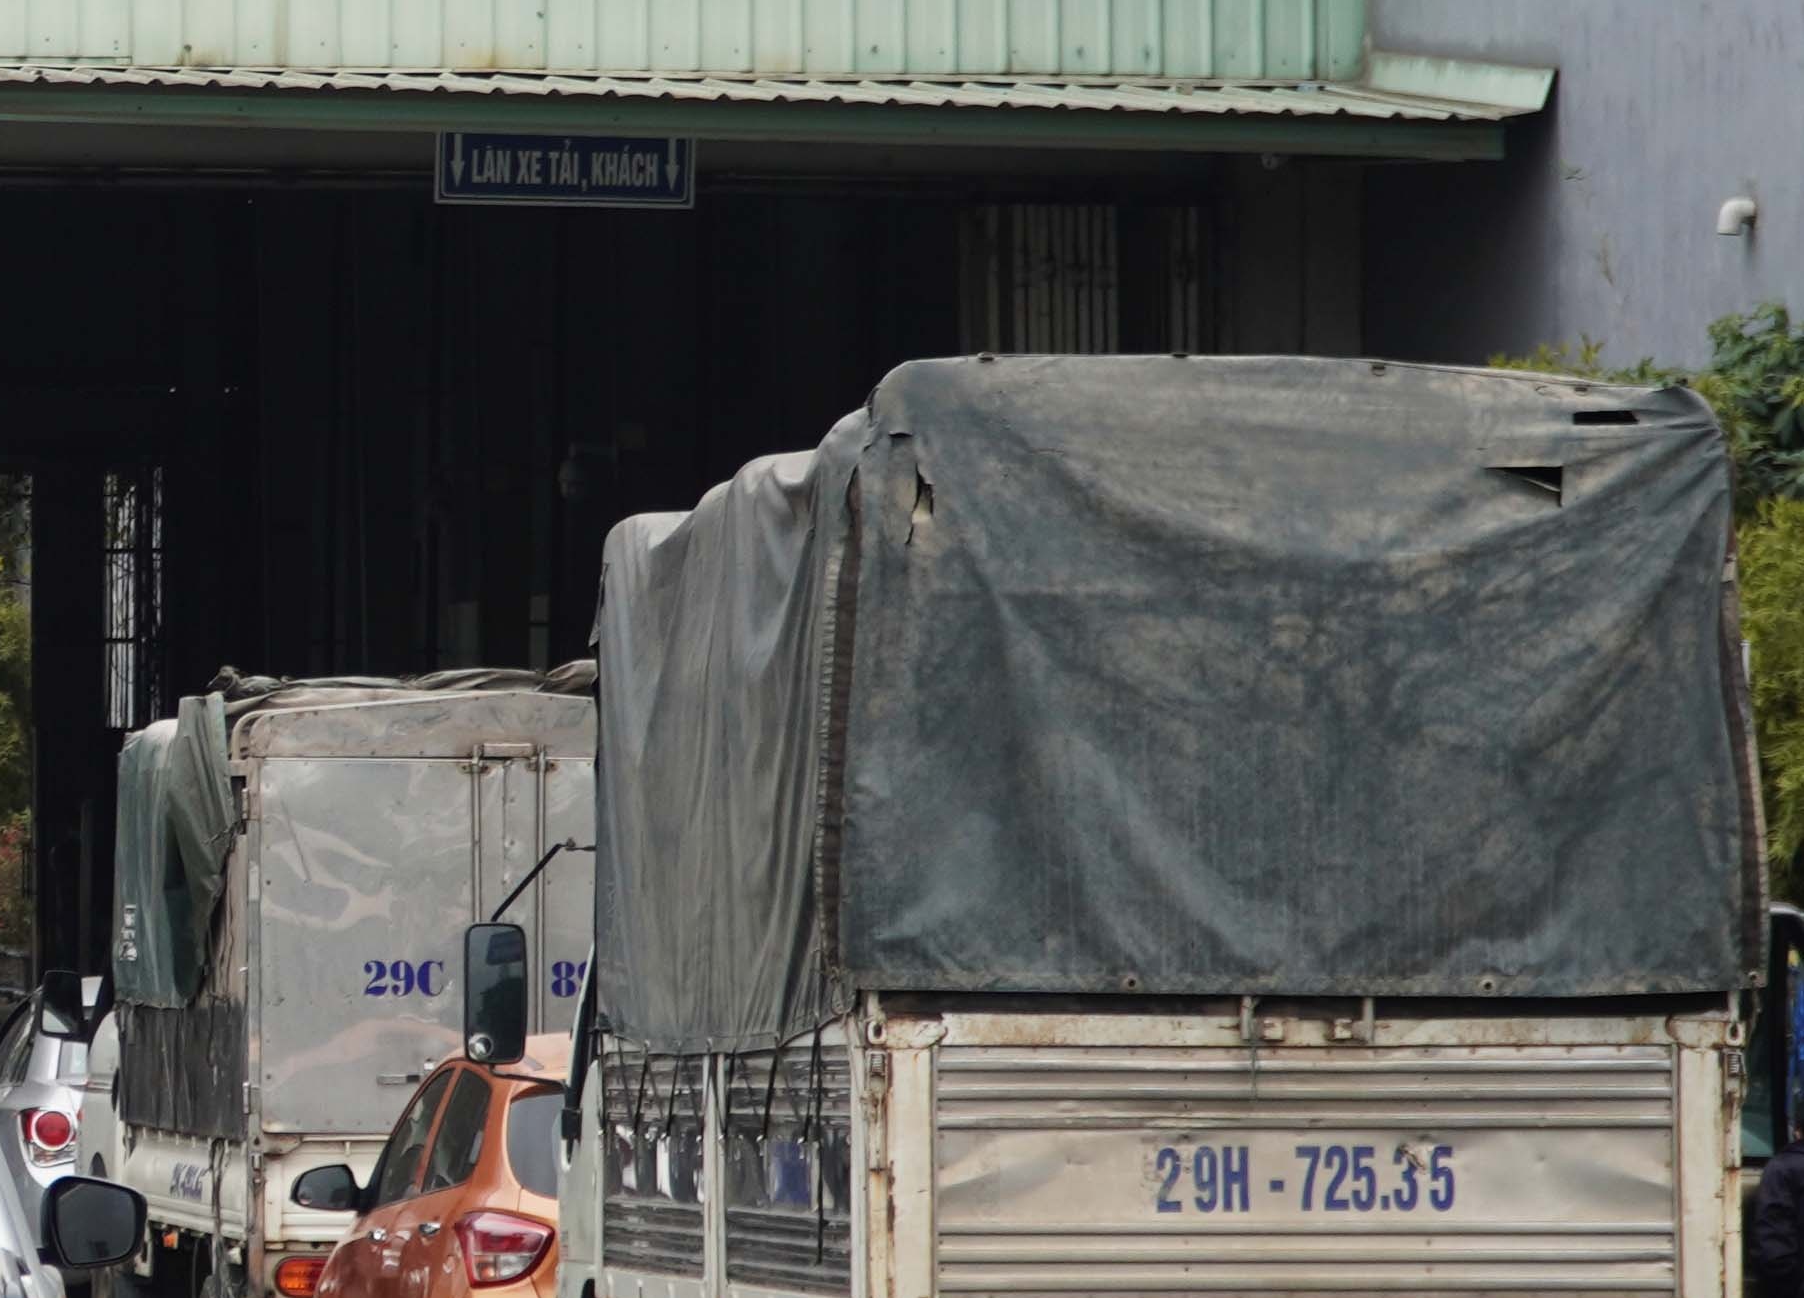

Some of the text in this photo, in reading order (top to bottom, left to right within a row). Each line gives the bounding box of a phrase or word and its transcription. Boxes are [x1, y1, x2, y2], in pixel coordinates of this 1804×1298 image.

[516, 151, 542, 184] XE
[592, 146, 659, 187] KHÁCH
[363, 959, 444, 997] 29C
[1155, 1144, 1250, 1214] 29H
[1294, 1144, 1456, 1212] 725.35
